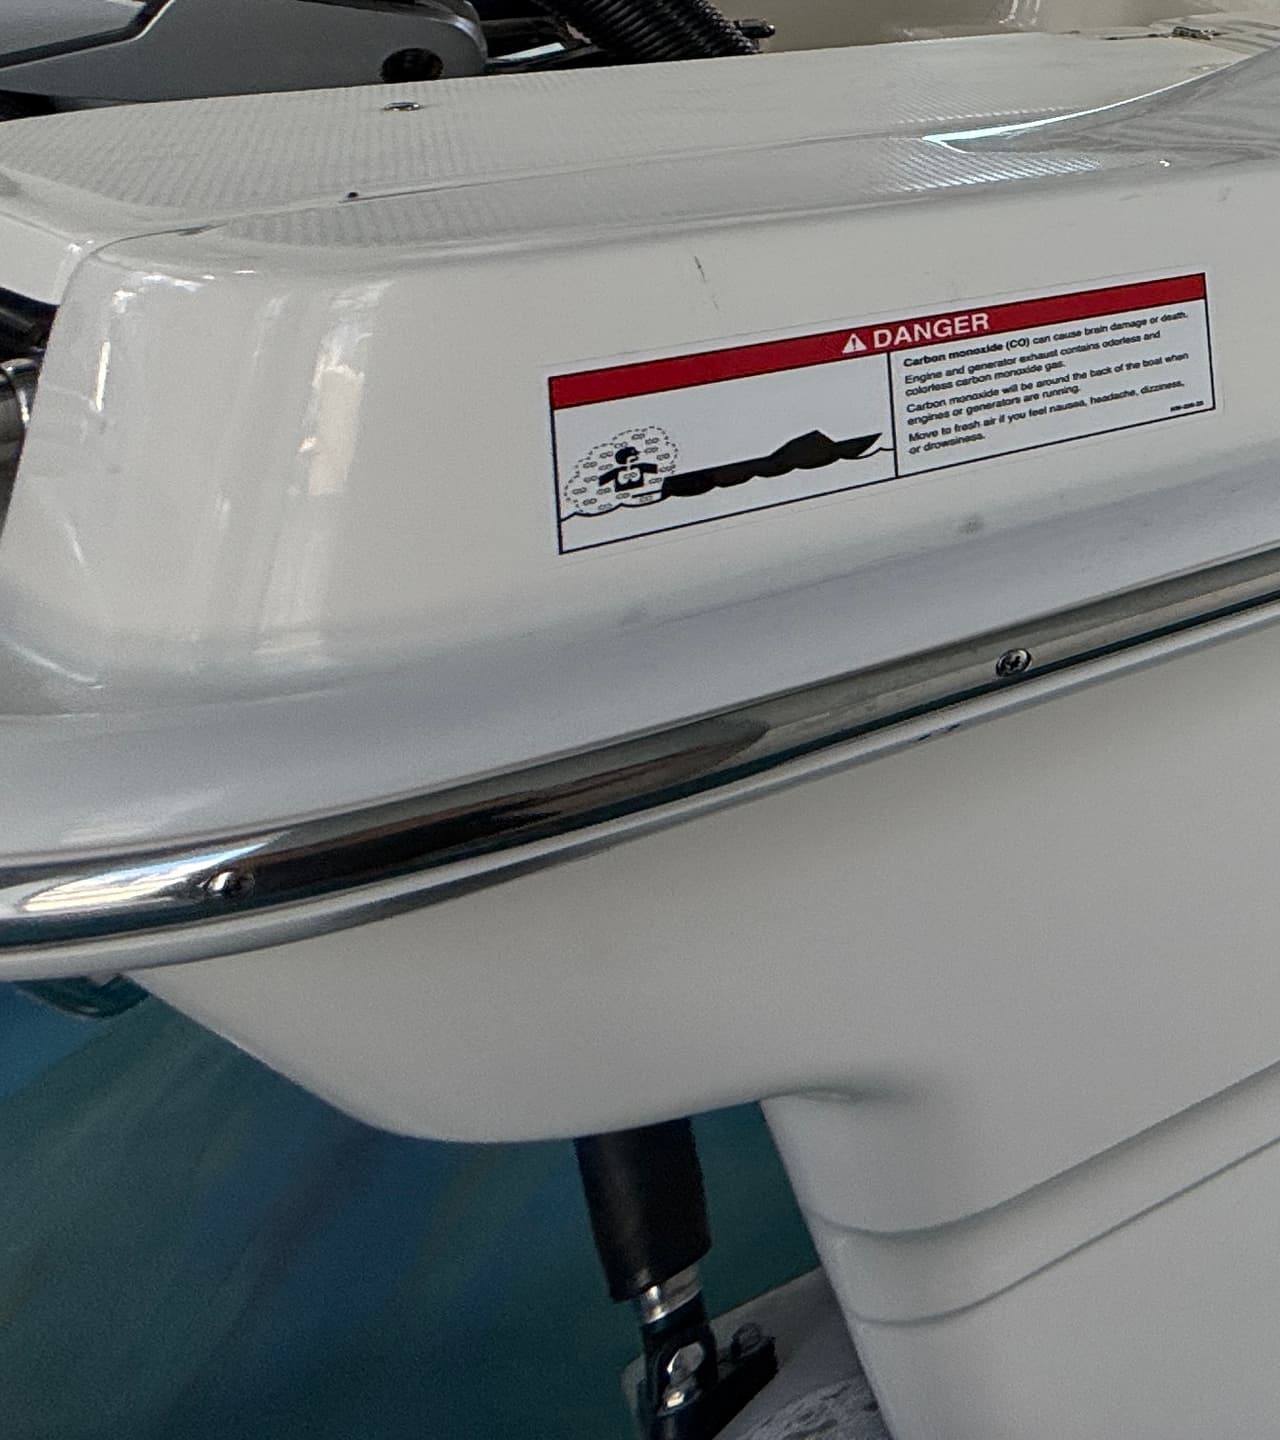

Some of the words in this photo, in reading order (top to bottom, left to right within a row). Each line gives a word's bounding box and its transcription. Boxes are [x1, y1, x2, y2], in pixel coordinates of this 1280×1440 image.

[873, 313, 989, 349] DANGER
[904, 354, 946, 367] Carbon
[949, 343, 1003, 359] monoxide
[1006, 338, 1029, 351] (CO)
[1033, 335, 1050, 344] can
[1053, 330, 1082, 340] cause
[1084, 325, 1108, 336] brain
[1110, 318, 1147, 331] damage
[905, 371, 942, 384] Engine
[946, 366, 964, 376] and
[968, 356, 1016, 374] generator
[1019, 349, 1058, 362] exhaust
[1060, 342, 1100, 355] contains
[1102, 335, 1141, 348] odorless
[1144, 330, 1160, 340] and
[905, 380, 953, 396] colorless
[955, 374, 992, 387] carbon
[995, 365, 1042, 379] monoxide
[907, 399, 945, 412] Carbon
[949, 389, 999, 404] monoxide
[1001, 384, 1018, 394] will
[1021, 381, 1033, 390] be
[1036, 374, 1070, 387] around
[1073, 371, 1087, 380] the
[1090, 366, 1112, 377] back
[1114, 364, 1123, 372] of
[1126, 361, 1140, 370] the
[1143, 357, 1162, 367] boat
[1165, 353, 1189, 362] when
[907, 411, 949, 426] engines
[952, 408, 963, 416] or
[966, 396, 1021, 415] generators
[1023, 392, 1039, 402] are
[1042, 385, 1080, 398] running.
[909, 431, 938, 441] Move
[955, 420, 980, 431] fresh
[983, 417, 997, 426] air
[999, 414, 1005, 423] if
[1008, 411, 1026, 423] you
[1029, 407, 1047, 417] feel
[909, 446, 921, 454] or
